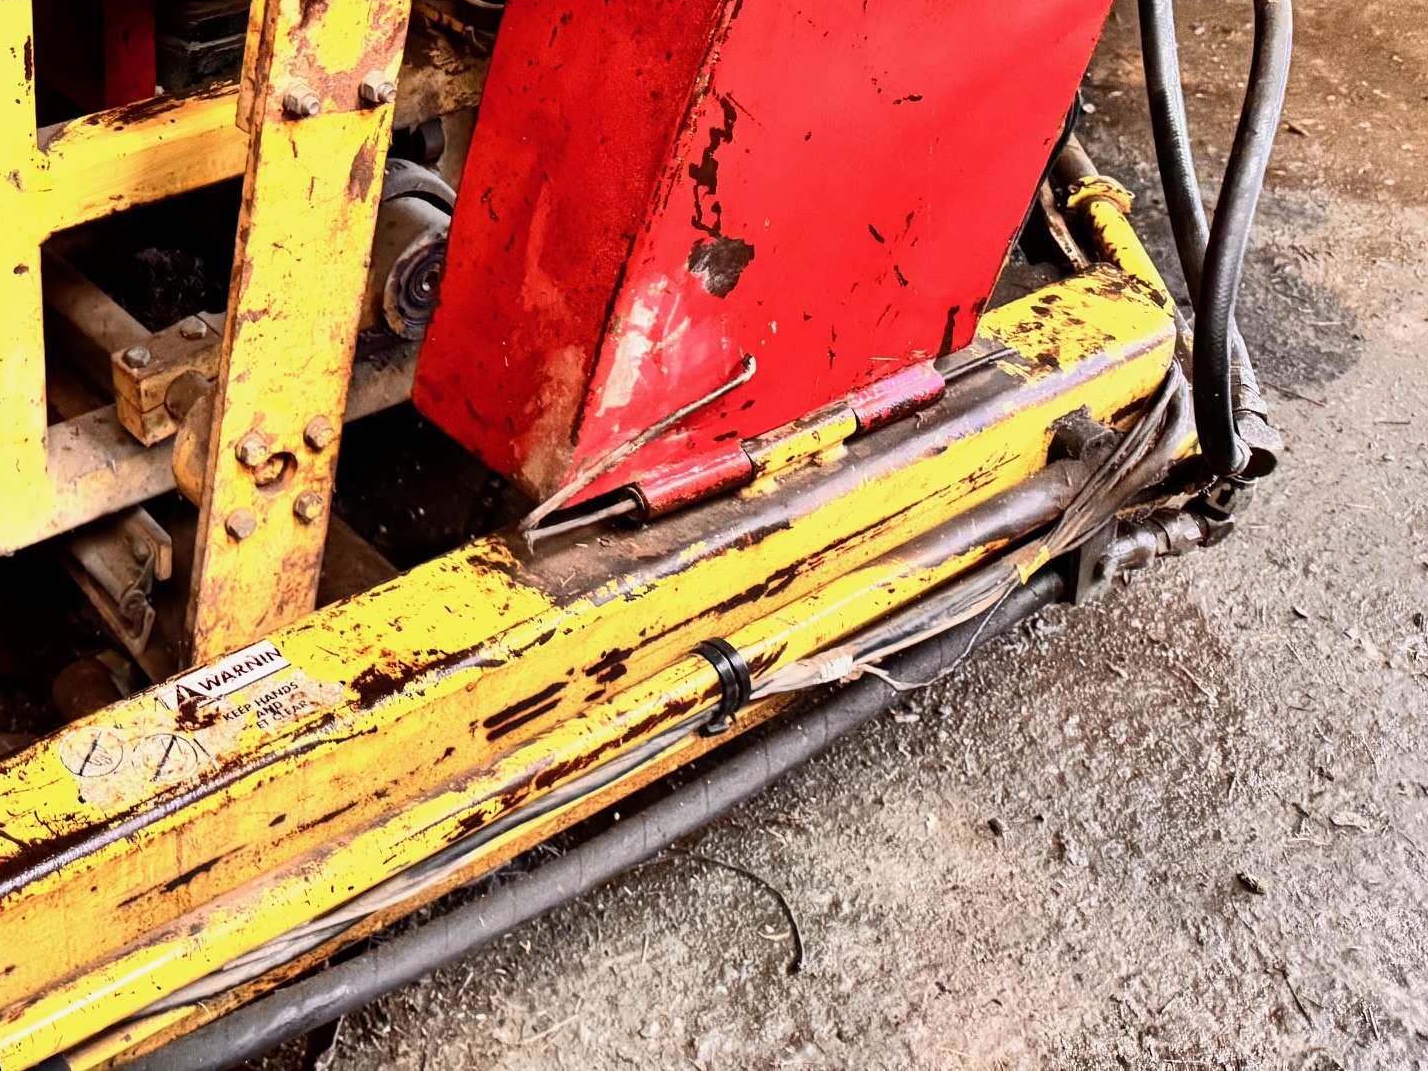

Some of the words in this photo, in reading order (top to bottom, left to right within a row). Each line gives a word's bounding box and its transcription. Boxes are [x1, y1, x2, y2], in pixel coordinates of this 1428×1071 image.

[198, 647, 283, 691] WARNIN
[222, 703, 251, 722] KEEP
[254, 681, 299, 707] HANDS
[256, 700, 284, 719] AND
[273, 699, 309, 721] CLEAR
